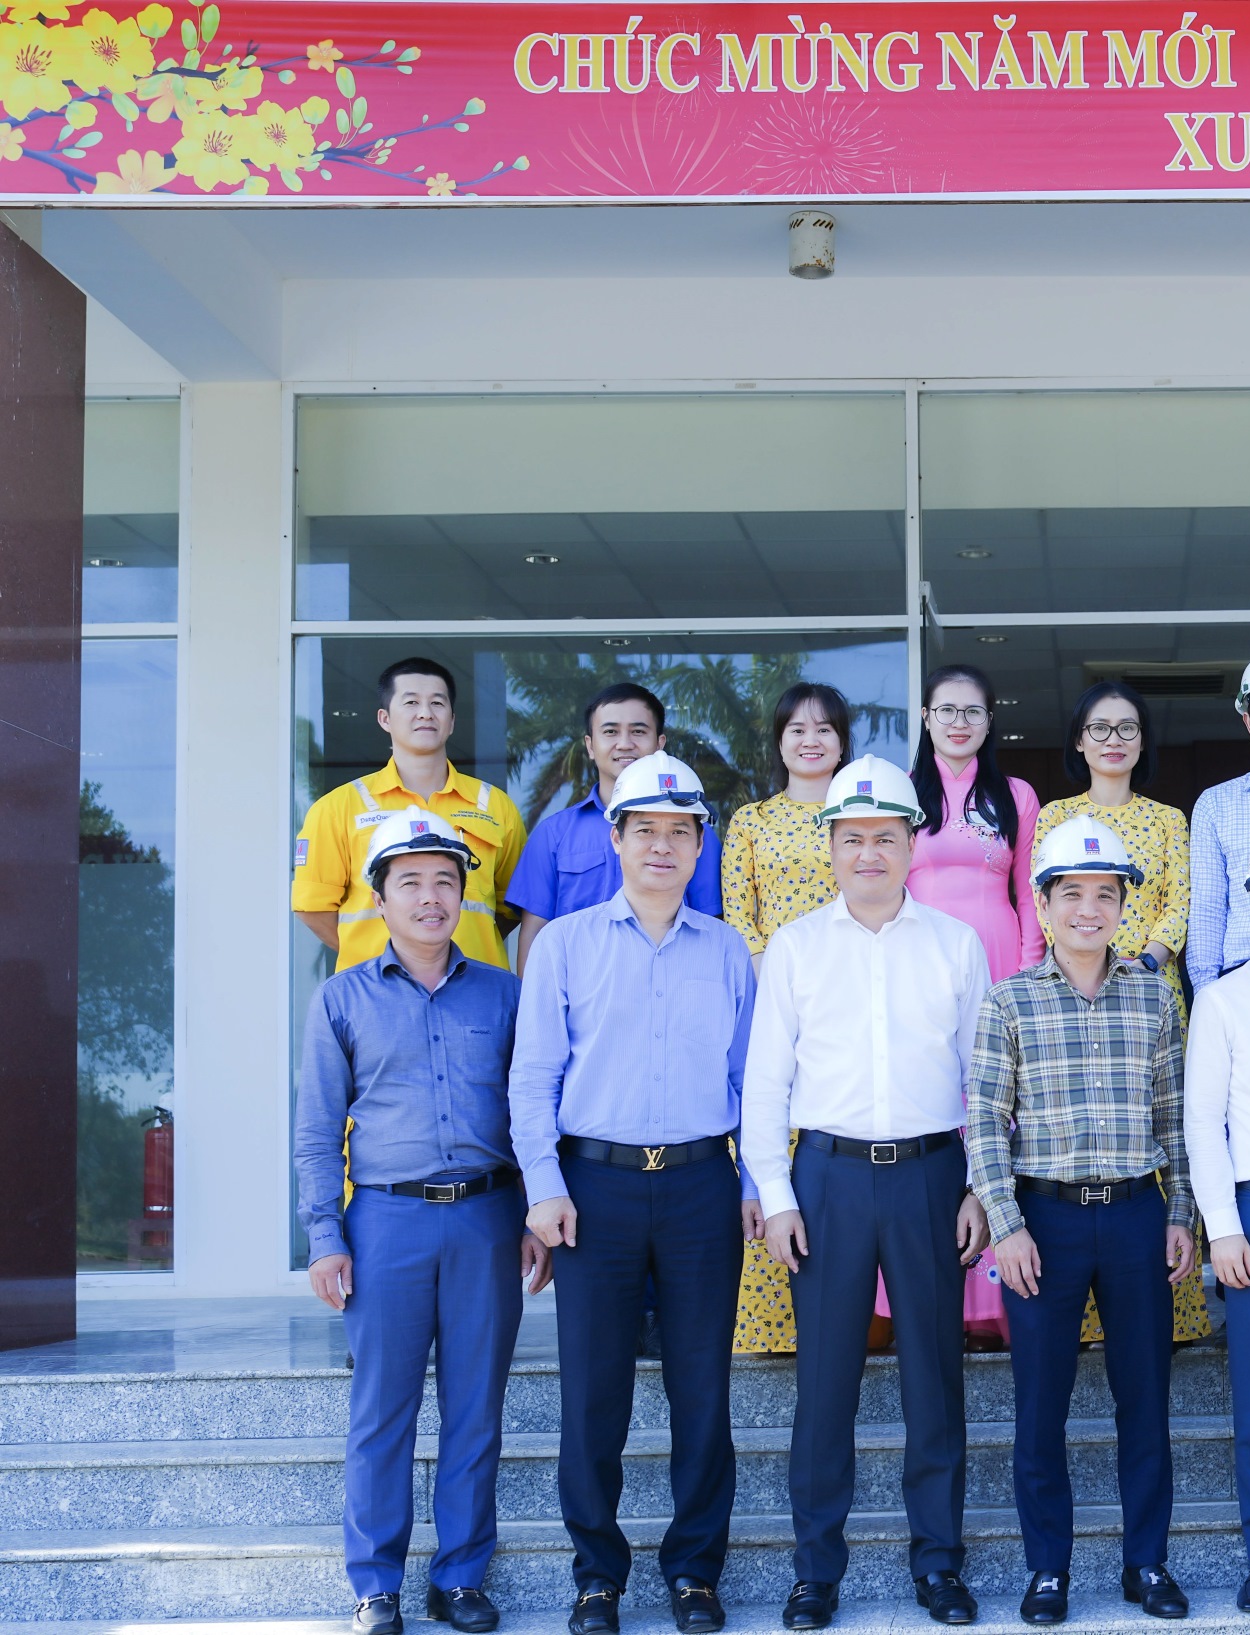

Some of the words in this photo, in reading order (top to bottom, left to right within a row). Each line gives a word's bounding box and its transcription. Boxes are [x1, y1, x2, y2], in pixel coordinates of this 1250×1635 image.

[514, 15, 701, 94] CHÚC
[715, 14, 923, 93] MỪNG
[935, 13, 1090, 91] NĂM
[1103, 11, 1237, 88] MỚI
